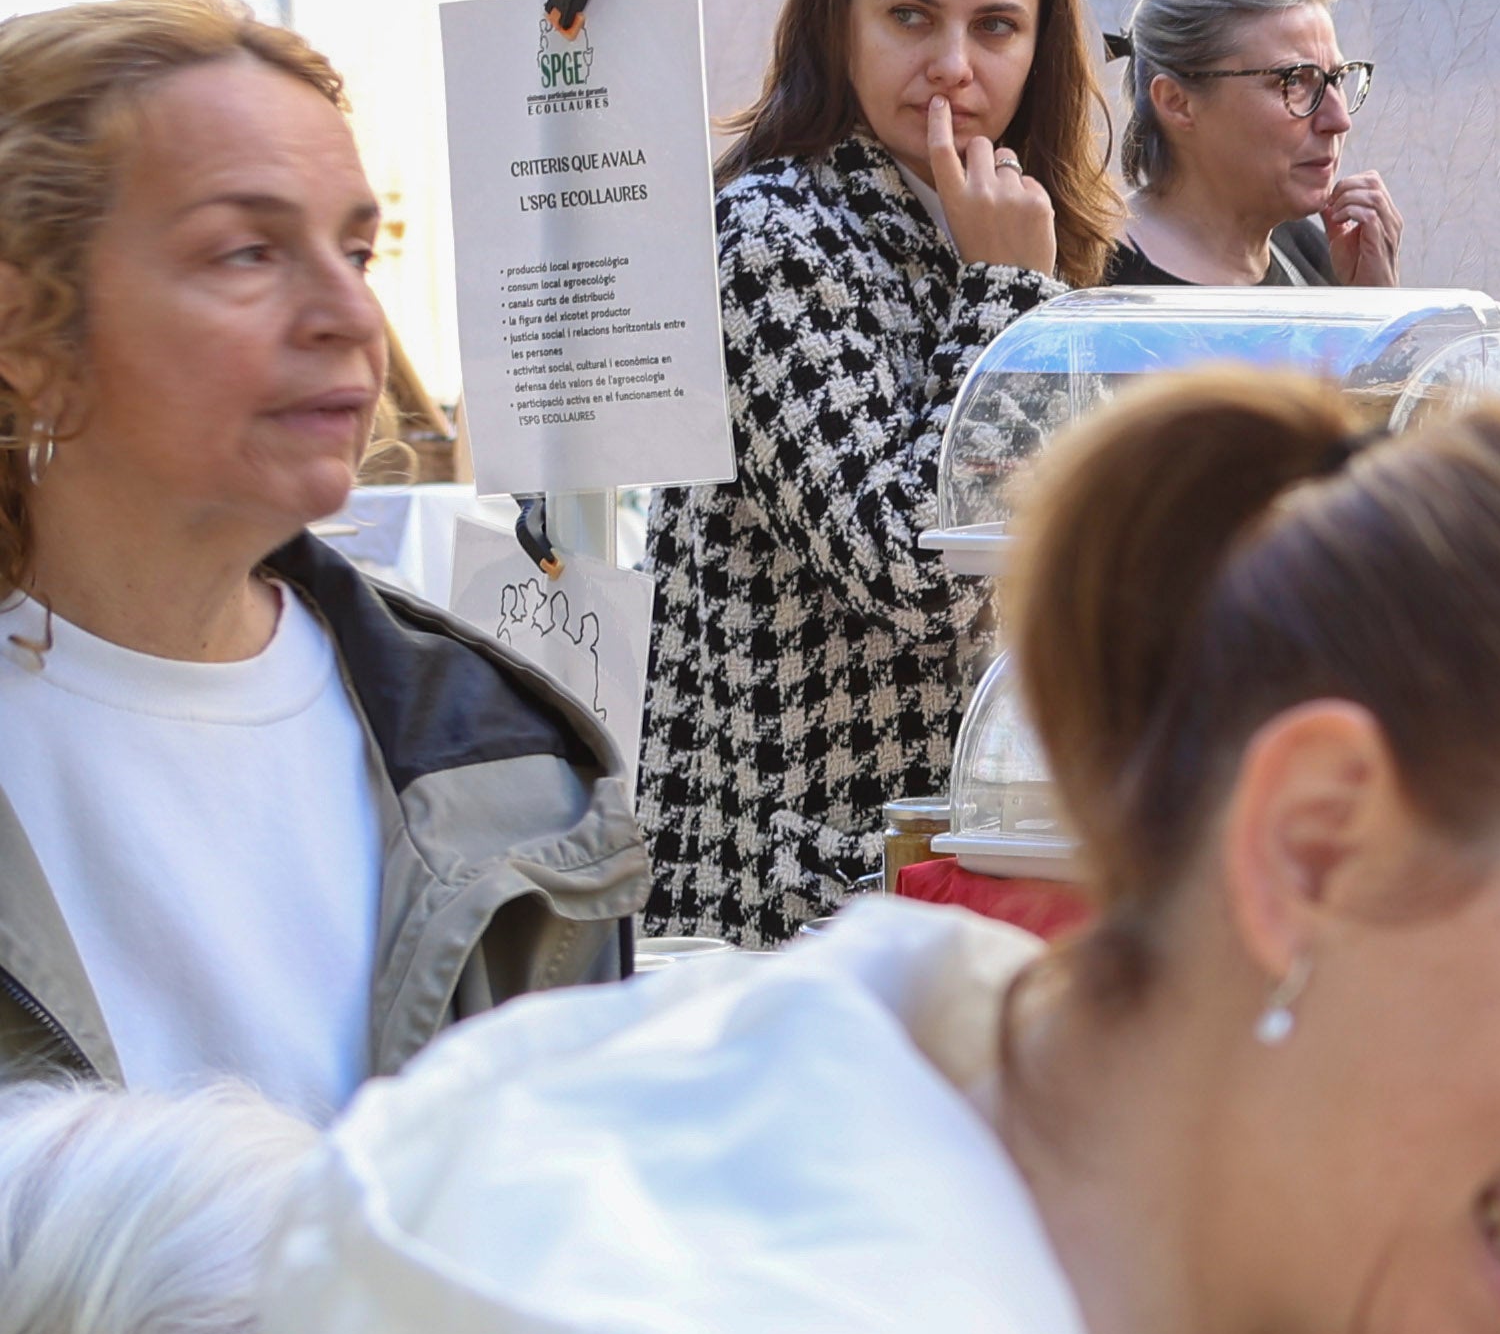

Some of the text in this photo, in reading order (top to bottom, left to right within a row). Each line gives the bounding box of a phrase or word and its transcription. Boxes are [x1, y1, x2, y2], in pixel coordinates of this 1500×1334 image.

[541, 51, 585, 88] SPGE
[528, 97, 609, 116] ECOLLAURES
[511, 149, 646, 177] CRITERIS QUE AVALA
[520, 184, 648, 212] L'SPG ECOLLAURES
[507, 256, 629, 277] producció local agroecològica
[507, 274, 616, 292] consum local agroecològic
[508, 292, 615, 309] canals curts de distribució
[509, 307, 631, 327] la figura del xicotet productor
[541, 329, 565, 340] social
[572, 325, 610, 337] relacions
[612, 321, 661, 334] horitzontals
[664, 319, 685, 329] entre
[511, 347, 563, 360] les persones
[513, 364, 546, 376] activitat
[576, 359, 607, 371] cultural
[615, 356, 659, 368] econòmica
[661, 355, 672, 364] en
[514, 381, 547, 393] defensa
[549, 379, 566, 390] dels
[569, 378, 593, 388] valors
[595, 376, 606, 386] de
[517, 387, 684, 411] participació activa en el funcionament de
[542, 411, 596, 424] ECOLLAURES
